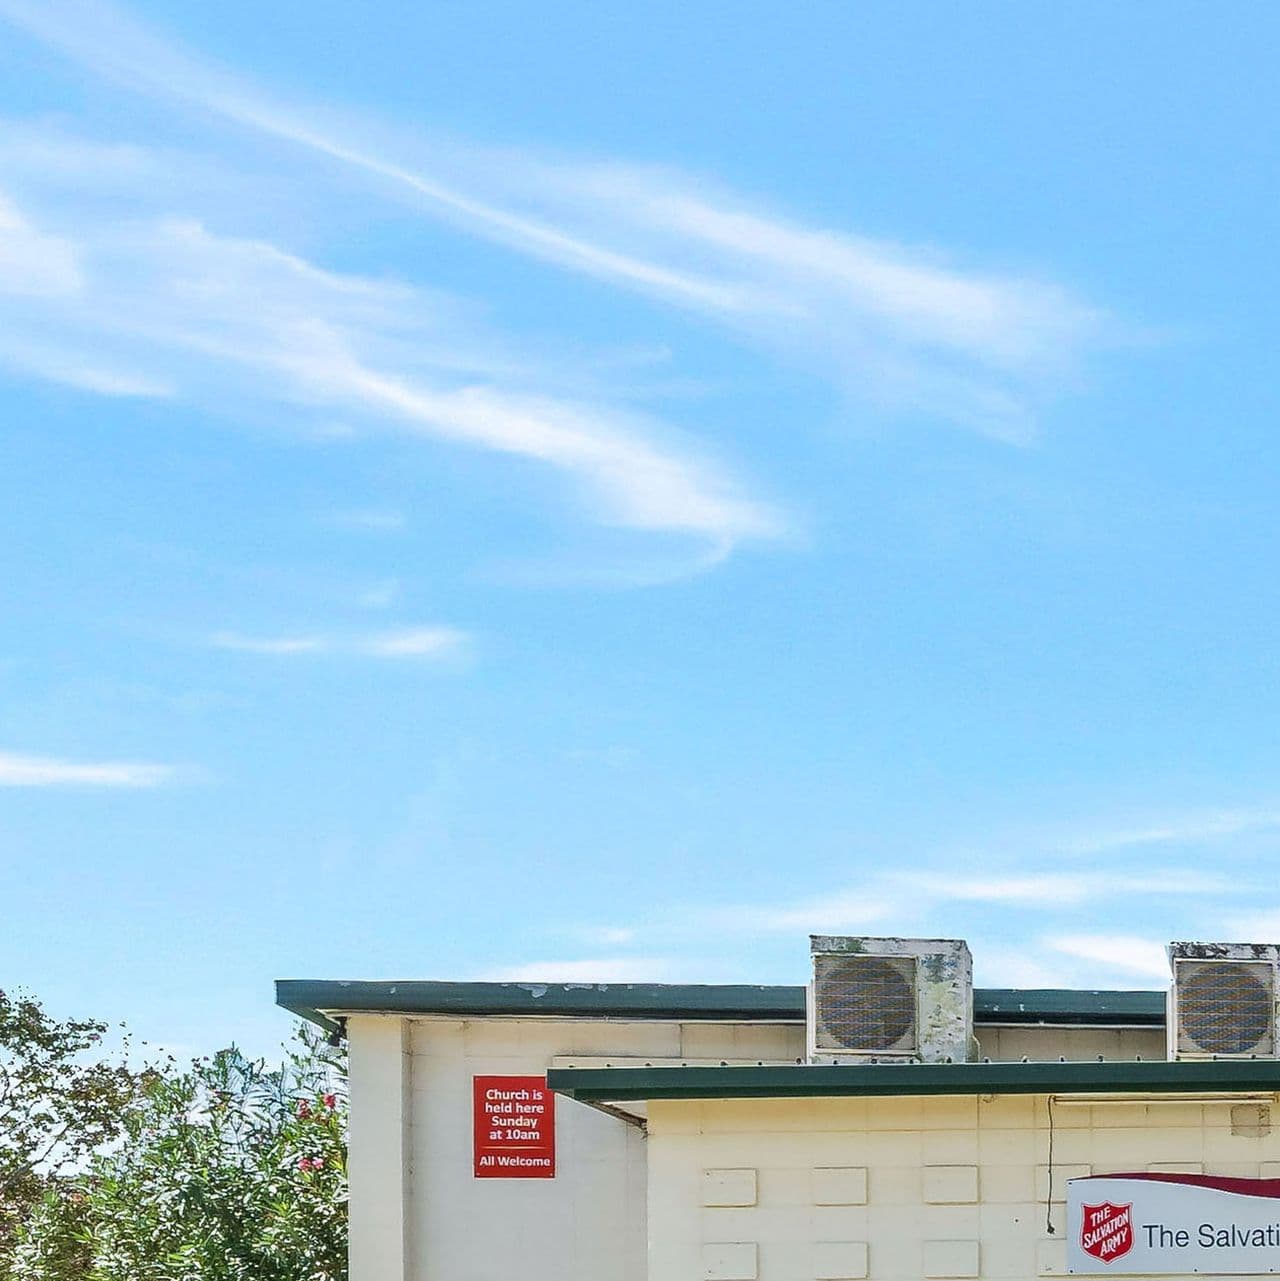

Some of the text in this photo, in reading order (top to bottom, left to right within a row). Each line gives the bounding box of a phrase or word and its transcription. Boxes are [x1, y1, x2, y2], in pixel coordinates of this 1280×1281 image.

[486, 1089, 543, 1100] Church is
[485, 1102, 544, 1113] held here
[491, 1115, 538, 1128] Sunday
[489, 1129, 540, 1140] at 10am
[479, 1156, 551, 1166] All Welcome
[1090, 1206, 1111, 1227] THE
[1084, 1209, 1129, 1249] SALVATION
[1100, 1227, 1128, 1257] ARMY
[1142, 1224, 1189, 1248] The
